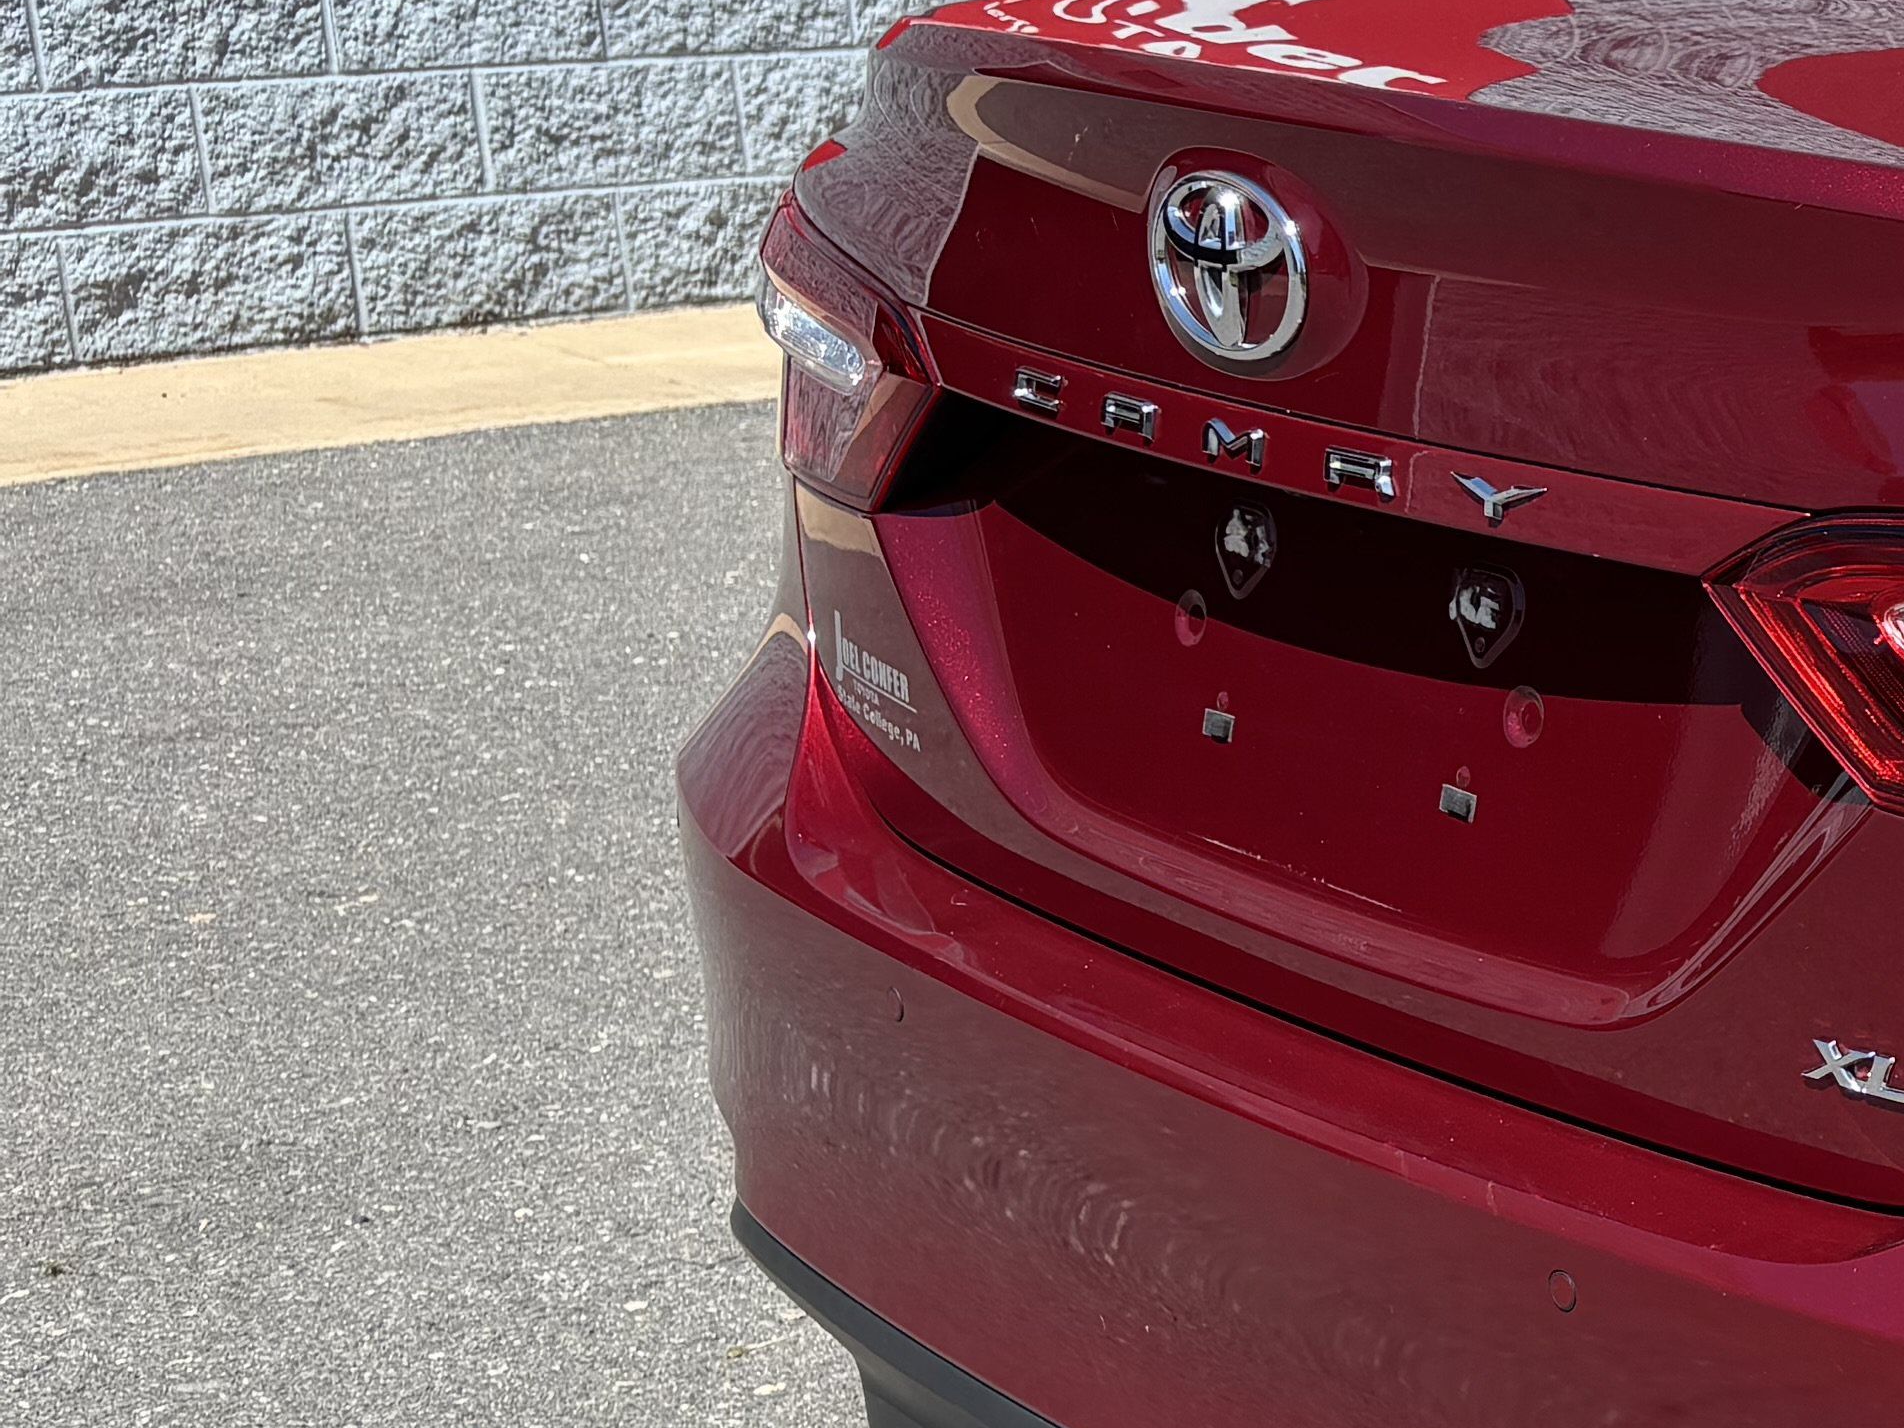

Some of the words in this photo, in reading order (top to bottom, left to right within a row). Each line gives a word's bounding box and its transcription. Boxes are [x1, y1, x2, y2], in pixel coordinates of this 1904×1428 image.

[1013, 366, 1548, 522] CAMRY
[862, 651, 910, 703] CONFER
[837, 685, 861, 715] State
[863, 703, 904, 746] College,
[905, 728, 921, 752] PA
